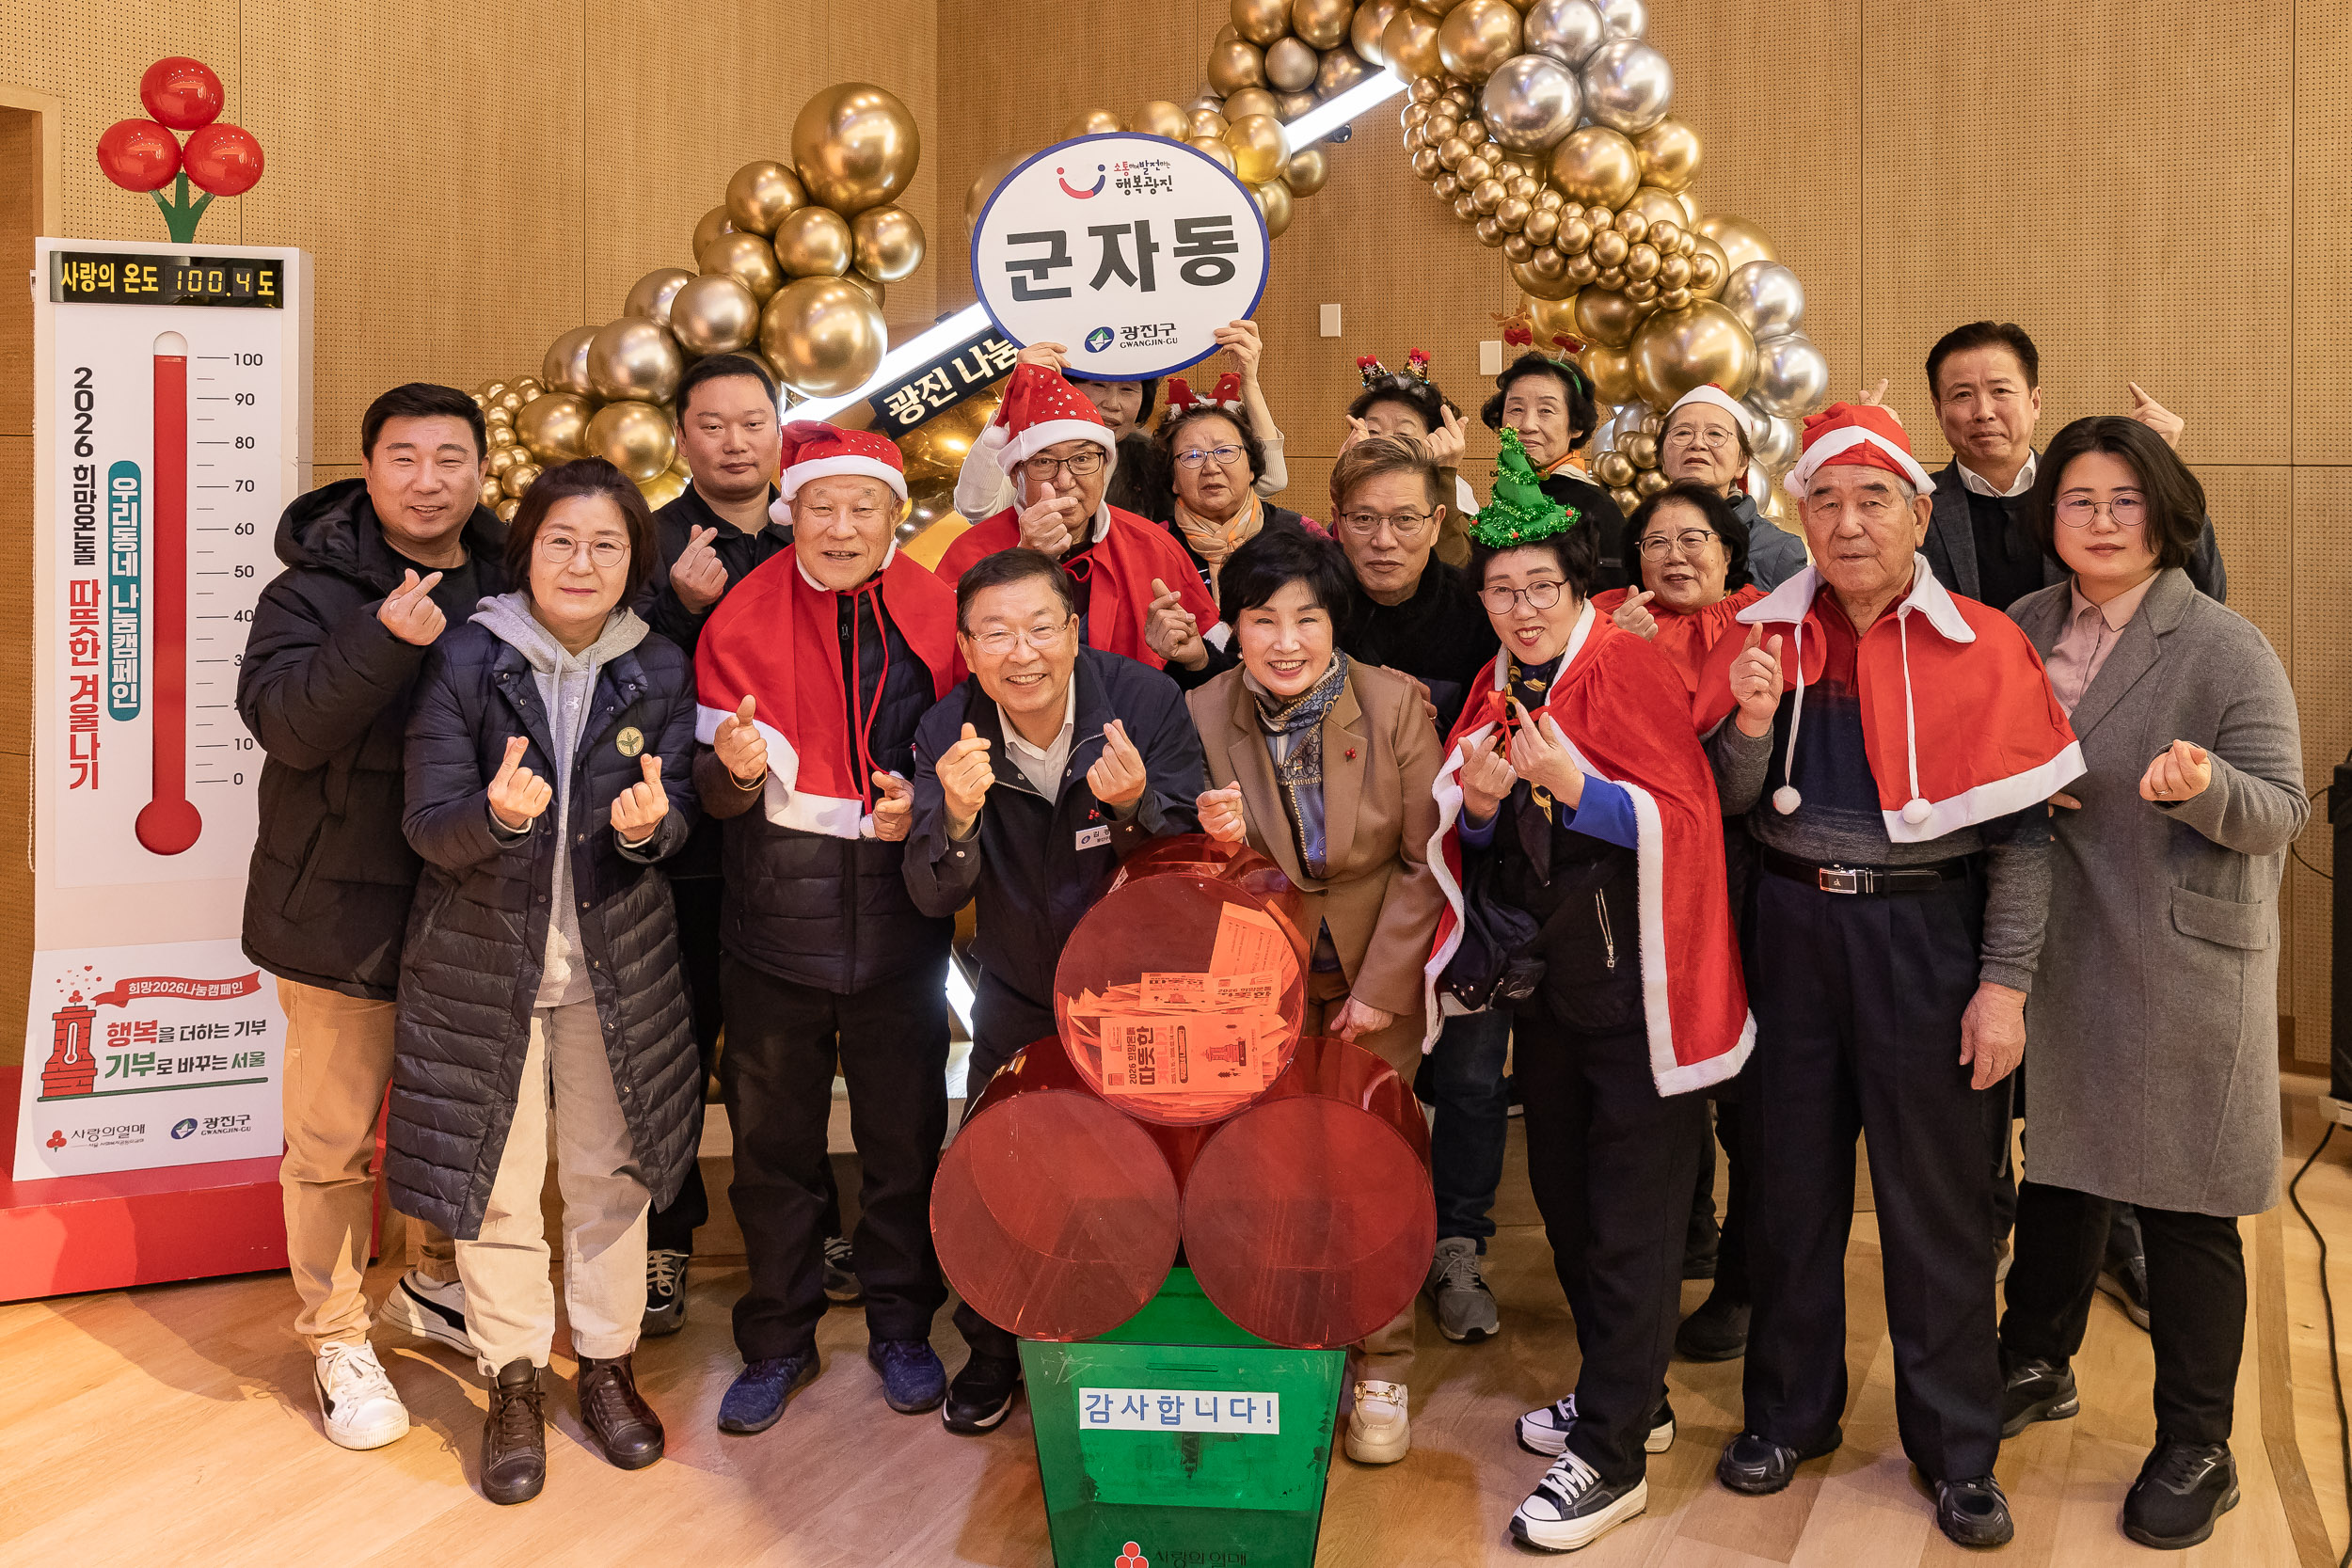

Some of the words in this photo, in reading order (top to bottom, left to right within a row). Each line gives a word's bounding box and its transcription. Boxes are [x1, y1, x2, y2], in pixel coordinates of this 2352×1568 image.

[1116, 175, 1172, 196] 행복광진
[1005, 214, 1239, 302] 군자동
[61, 261, 115, 293] 사랑의
[123, 263, 158, 293] 온도
[258, 271, 274, 295] 도
[1120, 323, 1176, 339] 광진구
[1120, 338, 1179, 349] GWANGJIN-GU
[234, 353, 263, 366] 100
[883, 367, 958, 424] 광진
[951, 339, 1019, 384] 나눔
[235, 393, 255, 406] 90
[73, 367, 94, 457] 2026
[235, 436, 255, 450] 80
[235, 480, 255, 493] 70
[73, 465, 97, 565] 희망온돌
[111, 477, 138, 577] 우리동네
[234, 523, 255, 536] 60
[234, 565, 255, 578] 50
[69, 579, 101, 666] 따뜻한
[234, 610, 254, 623] 40
[111, 583, 139, 708] 나눔캠페인
[69, 674, 101, 789] 겨울나기
[235, 737, 254, 751] 10
[233, 772, 244, 785] 0
[128, 981, 244, 997] 희망2026나눔캠페인
[106, 1020, 175, 1048] 행복을
[180, 1023, 230, 1041] 더하는
[233, 1019, 267, 1037] 기부
[104, 1051, 173, 1079] 기부로
[177, 1054, 228, 1074] 바꾸는
[231, 1051, 265, 1069] 서울
[1136, 1025, 1155, 1085] 따뜻한
[1129, 1063, 1137, 1085] 2026
[200, 1126, 251, 1136] GWANGJIN-GU
[202, 1114, 251, 1129] 광진구
[72, 1123, 146, 1142] 사랑의열매
[1085, 1394, 1272, 1426] 감사합니다!
